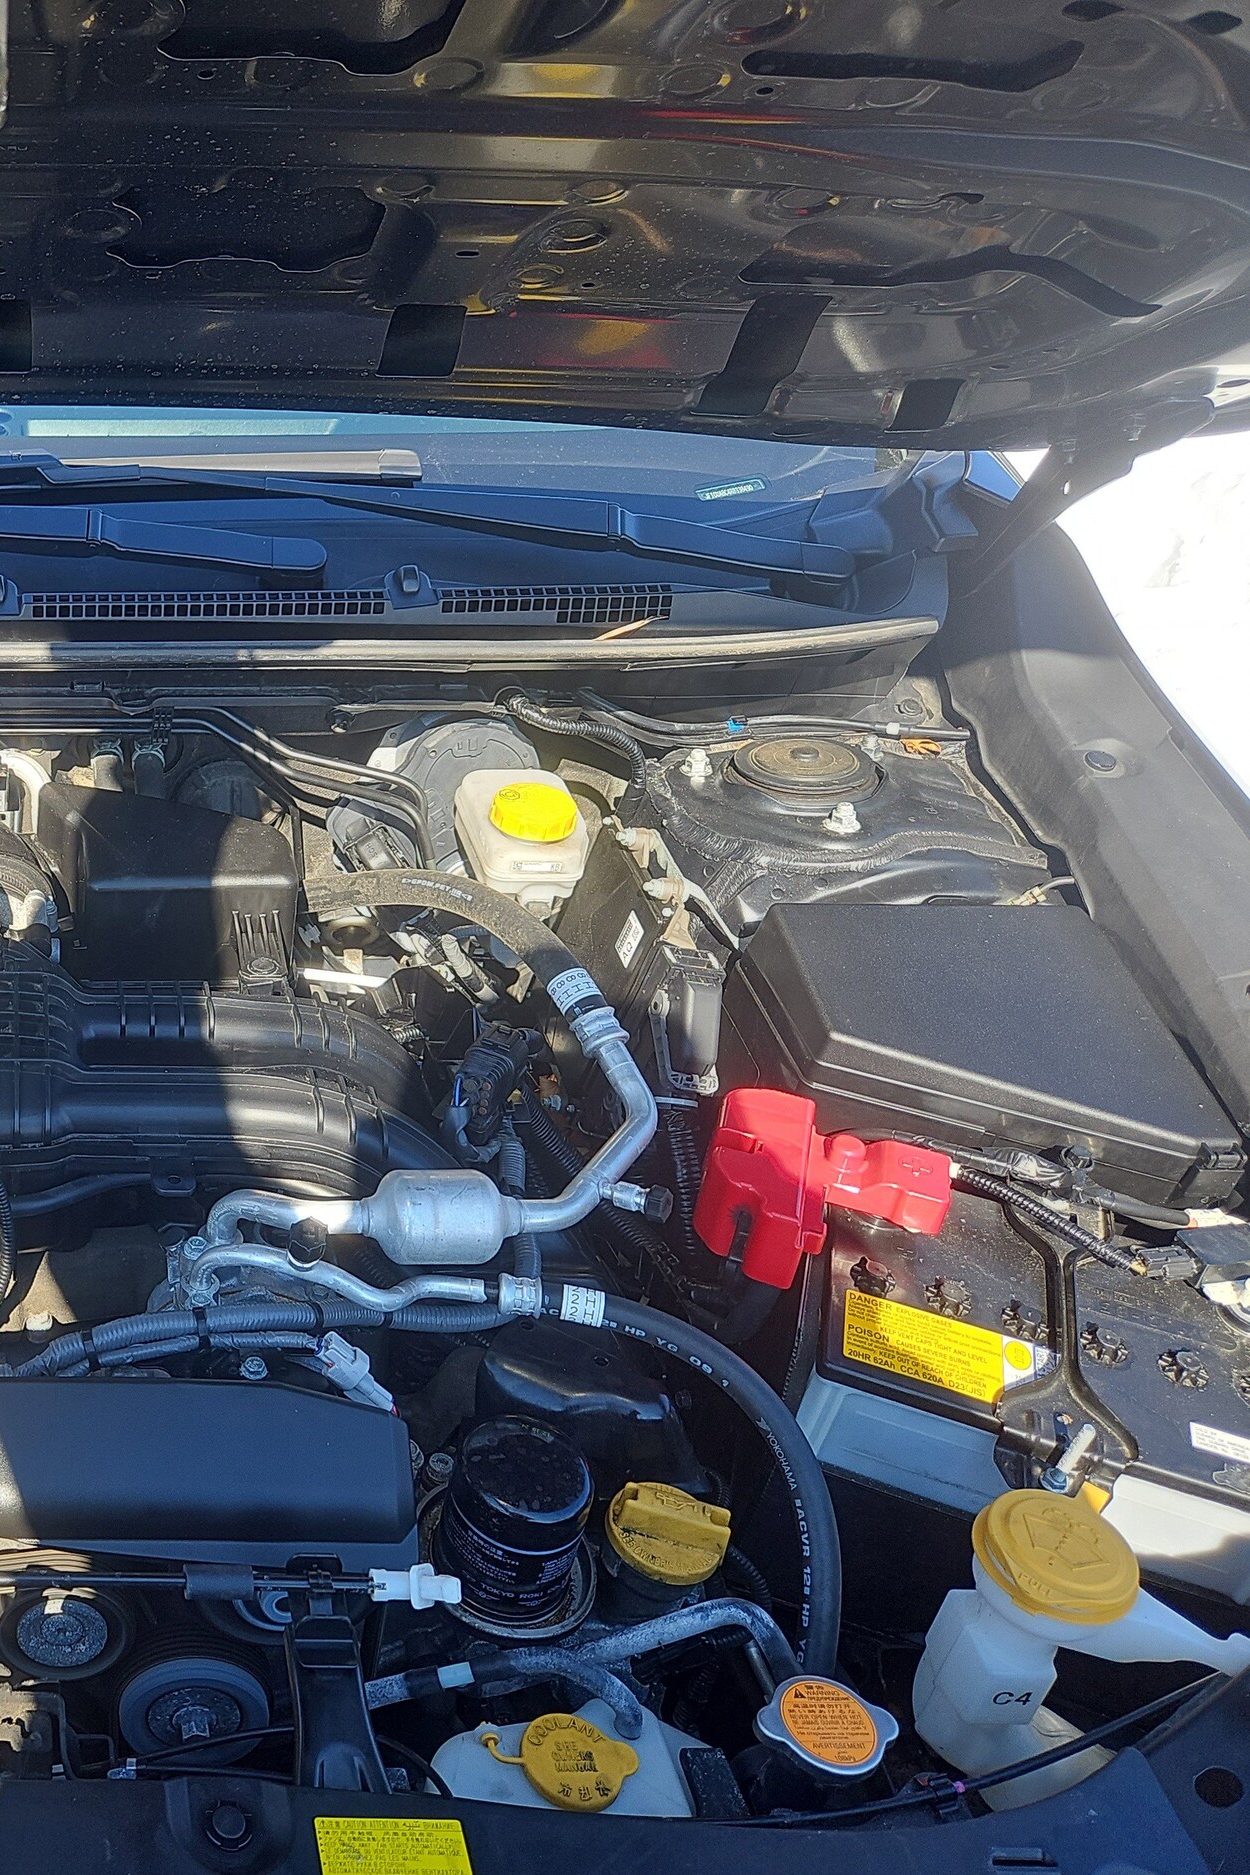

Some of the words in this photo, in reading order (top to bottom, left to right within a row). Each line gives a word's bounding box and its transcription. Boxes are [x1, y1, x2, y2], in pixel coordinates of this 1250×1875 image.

[849, 1291, 892, 1311] DANGER
[847, 1323, 889, 1342] POISON
[847, 1347, 870, 1361] 20HR
[873, 1355, 895, 1369] 62Ah
[900, 1364, 919, 1377] CCA
[922, 1370, 944, 1384] 620A
[766, 1432, 798, 1491] YOKOHAMA
[619, 1531, 635, 1548] SEE
[481, 1582, 515, 1598] TOKYO
[519, 1591, 544, 1599] ROKI
[992, 1691, 1033, 1706] C4
[527, 1717, 605, 1746] COOLANT
[554, 1741, 578, 1751] SEE
[555, 1761, 598, 1773] MANUAL
